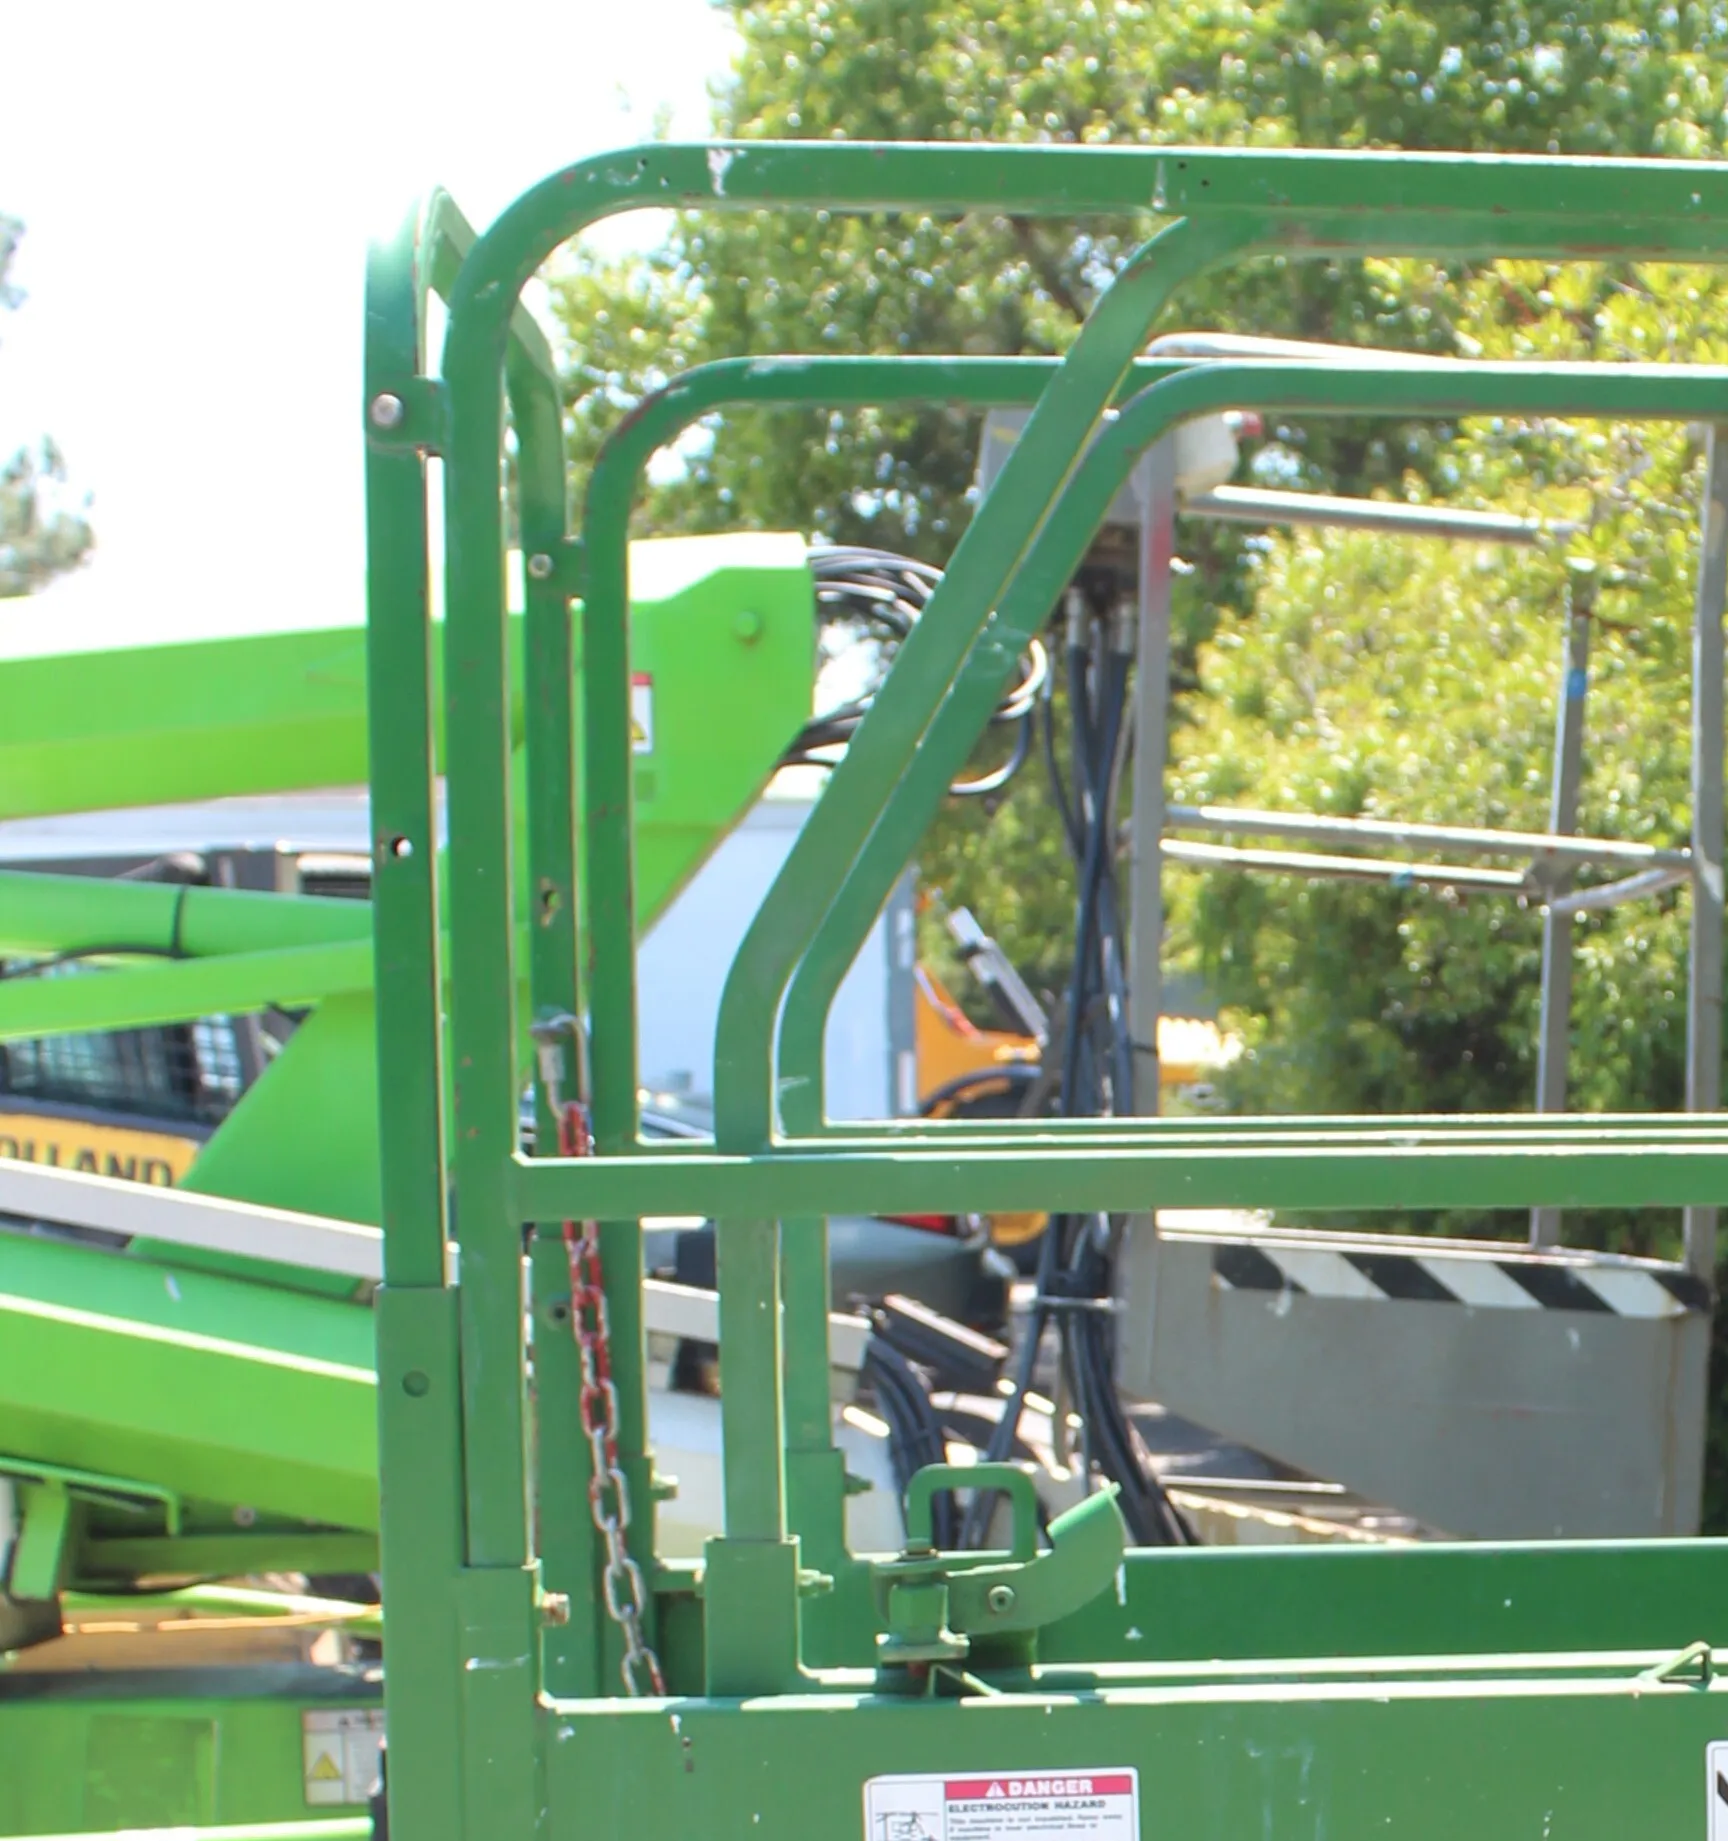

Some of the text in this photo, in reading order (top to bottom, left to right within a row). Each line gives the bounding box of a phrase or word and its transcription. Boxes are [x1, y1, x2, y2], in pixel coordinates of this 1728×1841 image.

[1007, 1779, 1093, 1797] DANGER
[948, 1799, 1106, 1813] ELECTROCUTION HAZARD
